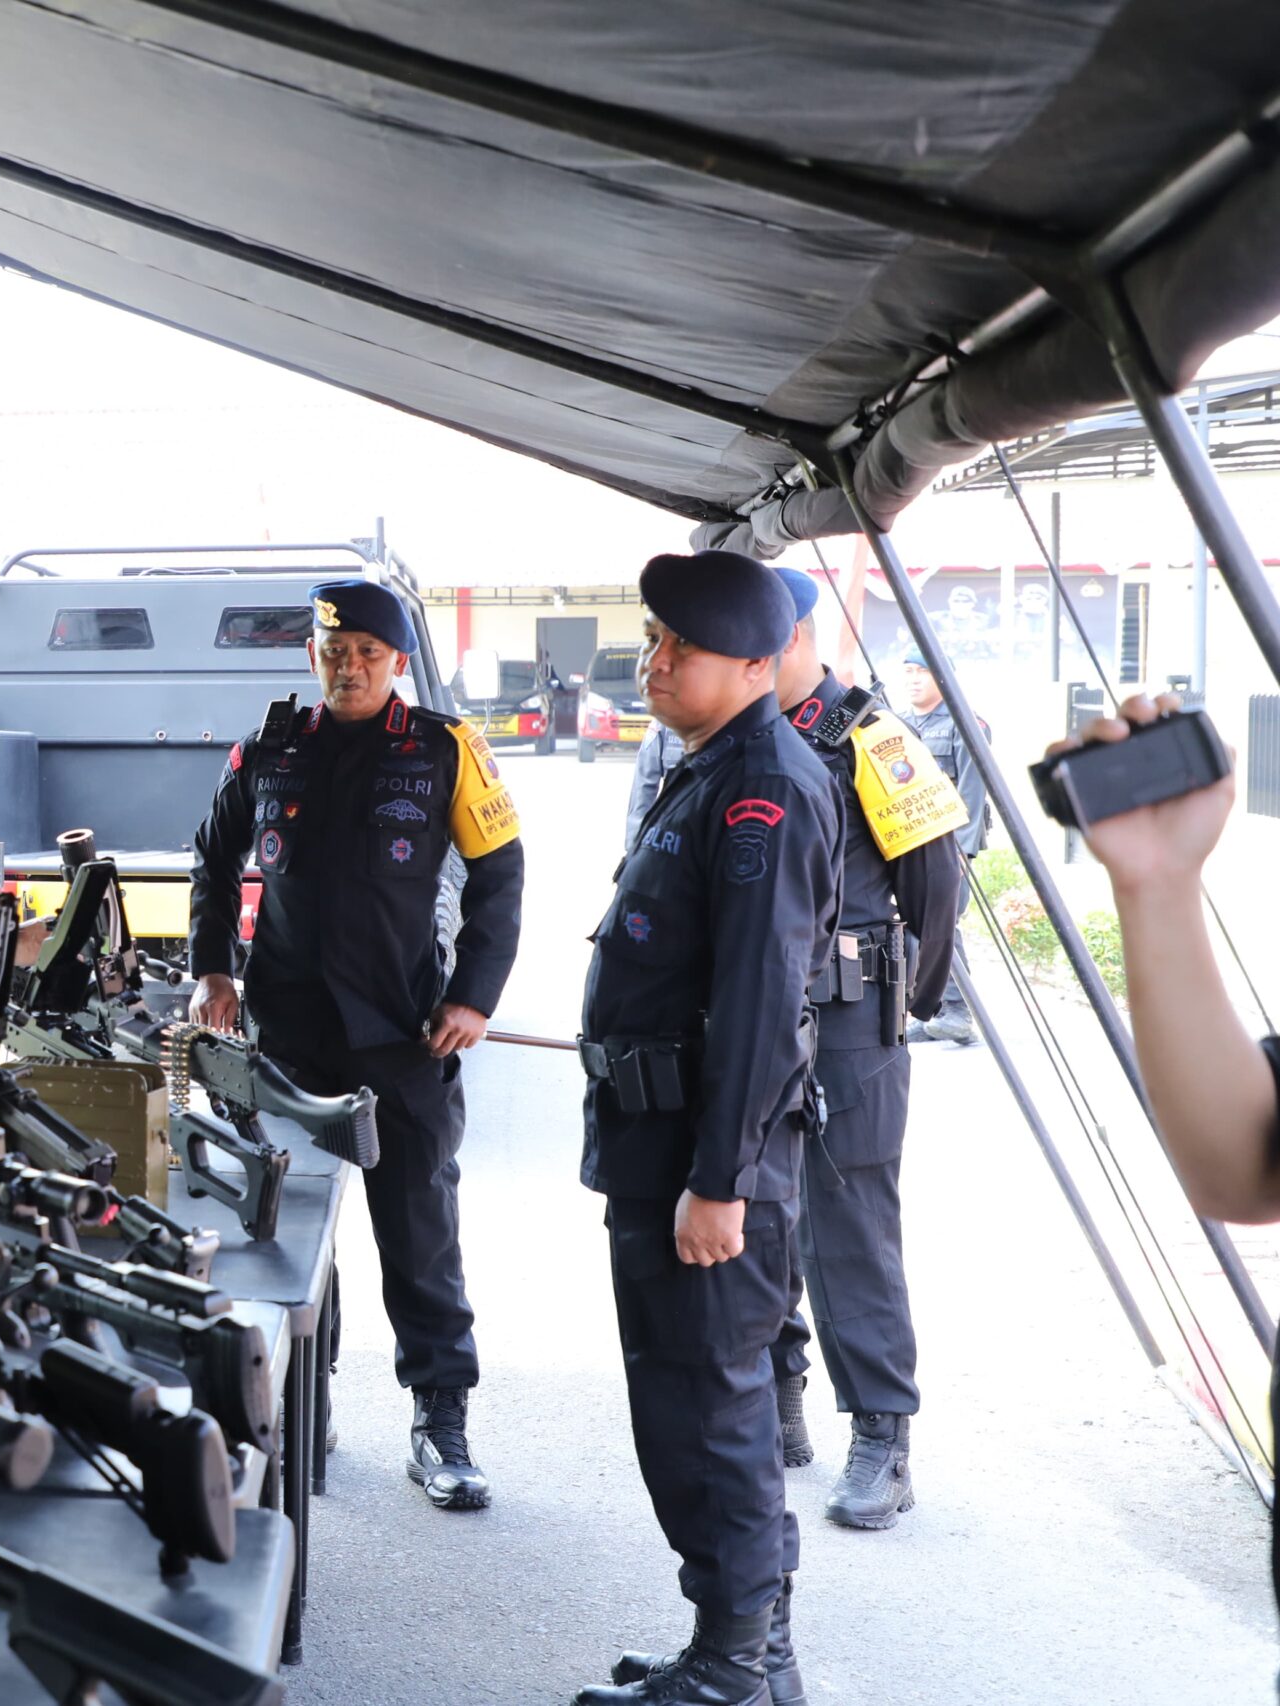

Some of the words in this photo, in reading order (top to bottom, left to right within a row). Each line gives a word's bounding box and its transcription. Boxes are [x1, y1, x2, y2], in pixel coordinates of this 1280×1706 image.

[872, 737, 902, 755] POLDA
[376, 777, 432, 796] POLRI
[640, 826, 682, 855] OLRI
